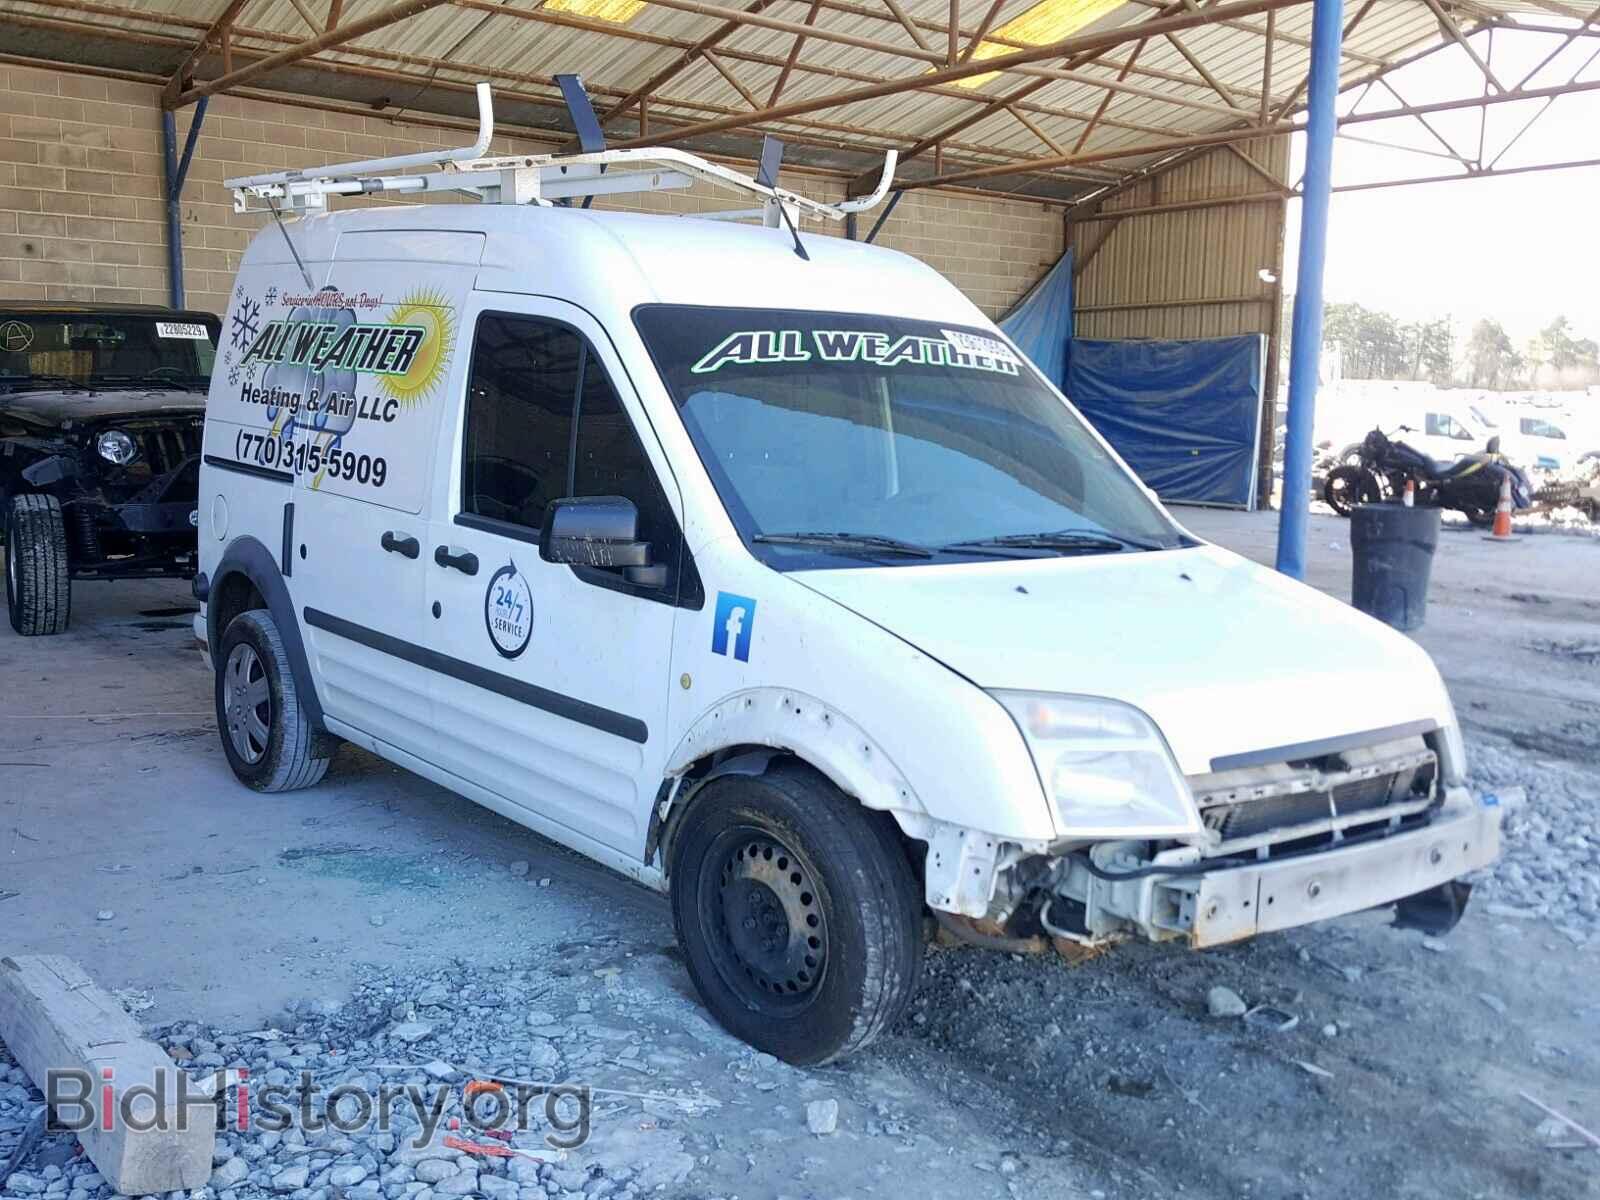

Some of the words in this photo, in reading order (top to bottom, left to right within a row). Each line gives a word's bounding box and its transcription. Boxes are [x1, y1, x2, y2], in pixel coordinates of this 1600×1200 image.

[240, 321, 293, 367] ALL
[290, 322, 426, 377] WEATHER
[691, 330, 812, 373] ALL
[240, 382, 302, 415] Heating
[306, 389, 320, 412] &
[325, 392, 354, 417] Air
[357, 395, 399, 423] LLC
[235, 429, 387, 487] (770)315-5909
[495, 585, 524, 623] 24/7
[494, 617, 523, 638] SERVICE
